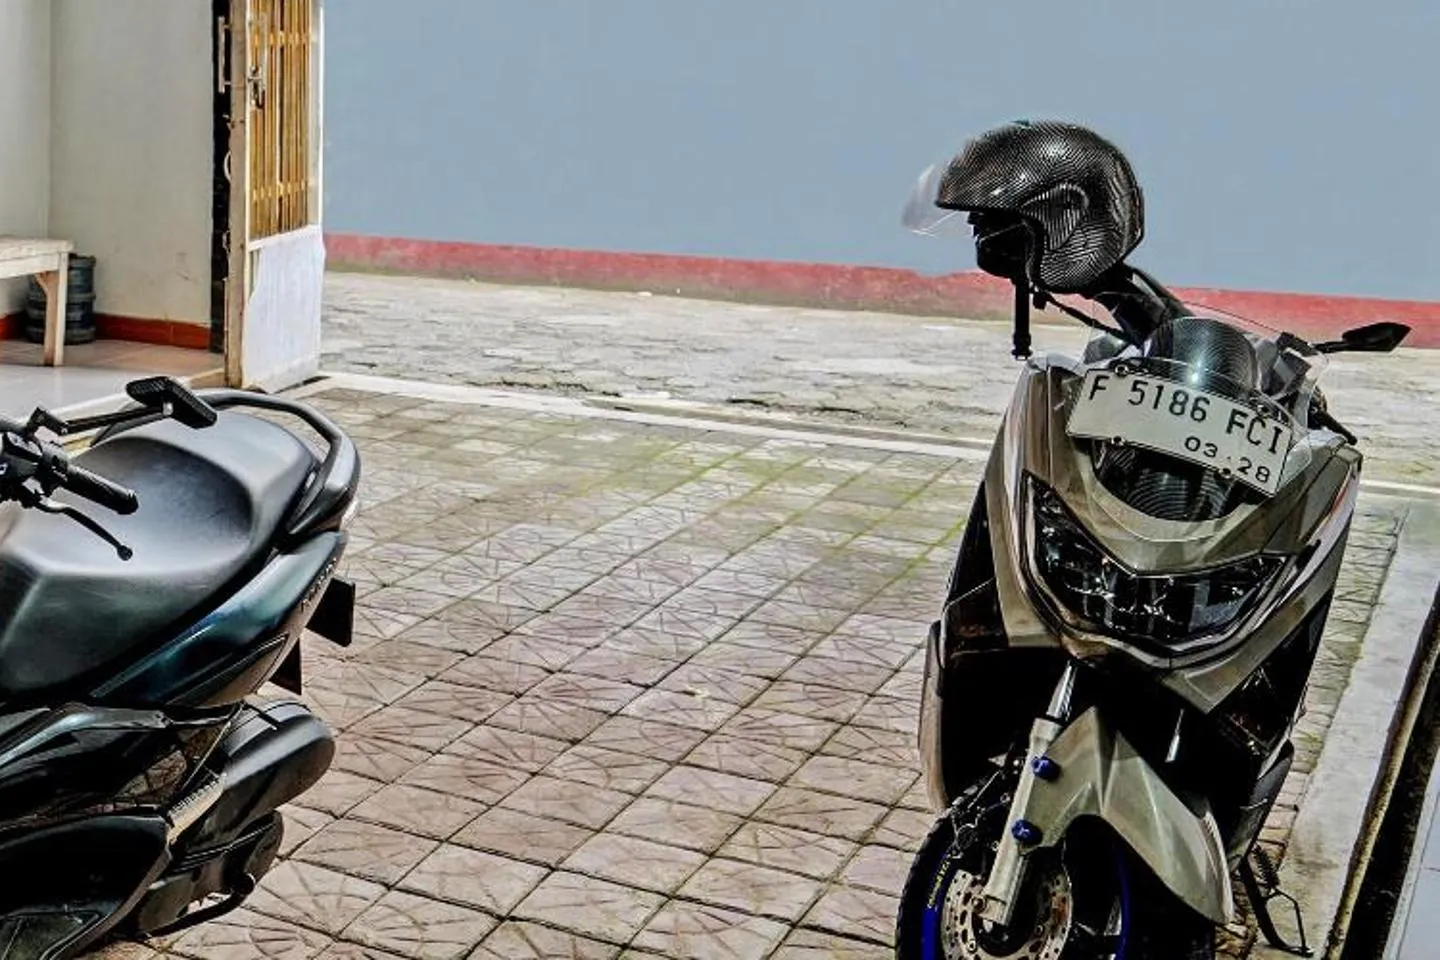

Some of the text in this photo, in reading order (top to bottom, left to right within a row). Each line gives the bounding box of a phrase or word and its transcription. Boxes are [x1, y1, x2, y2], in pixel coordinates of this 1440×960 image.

[1088, 374, 1283, 454] F 5186 FCI
